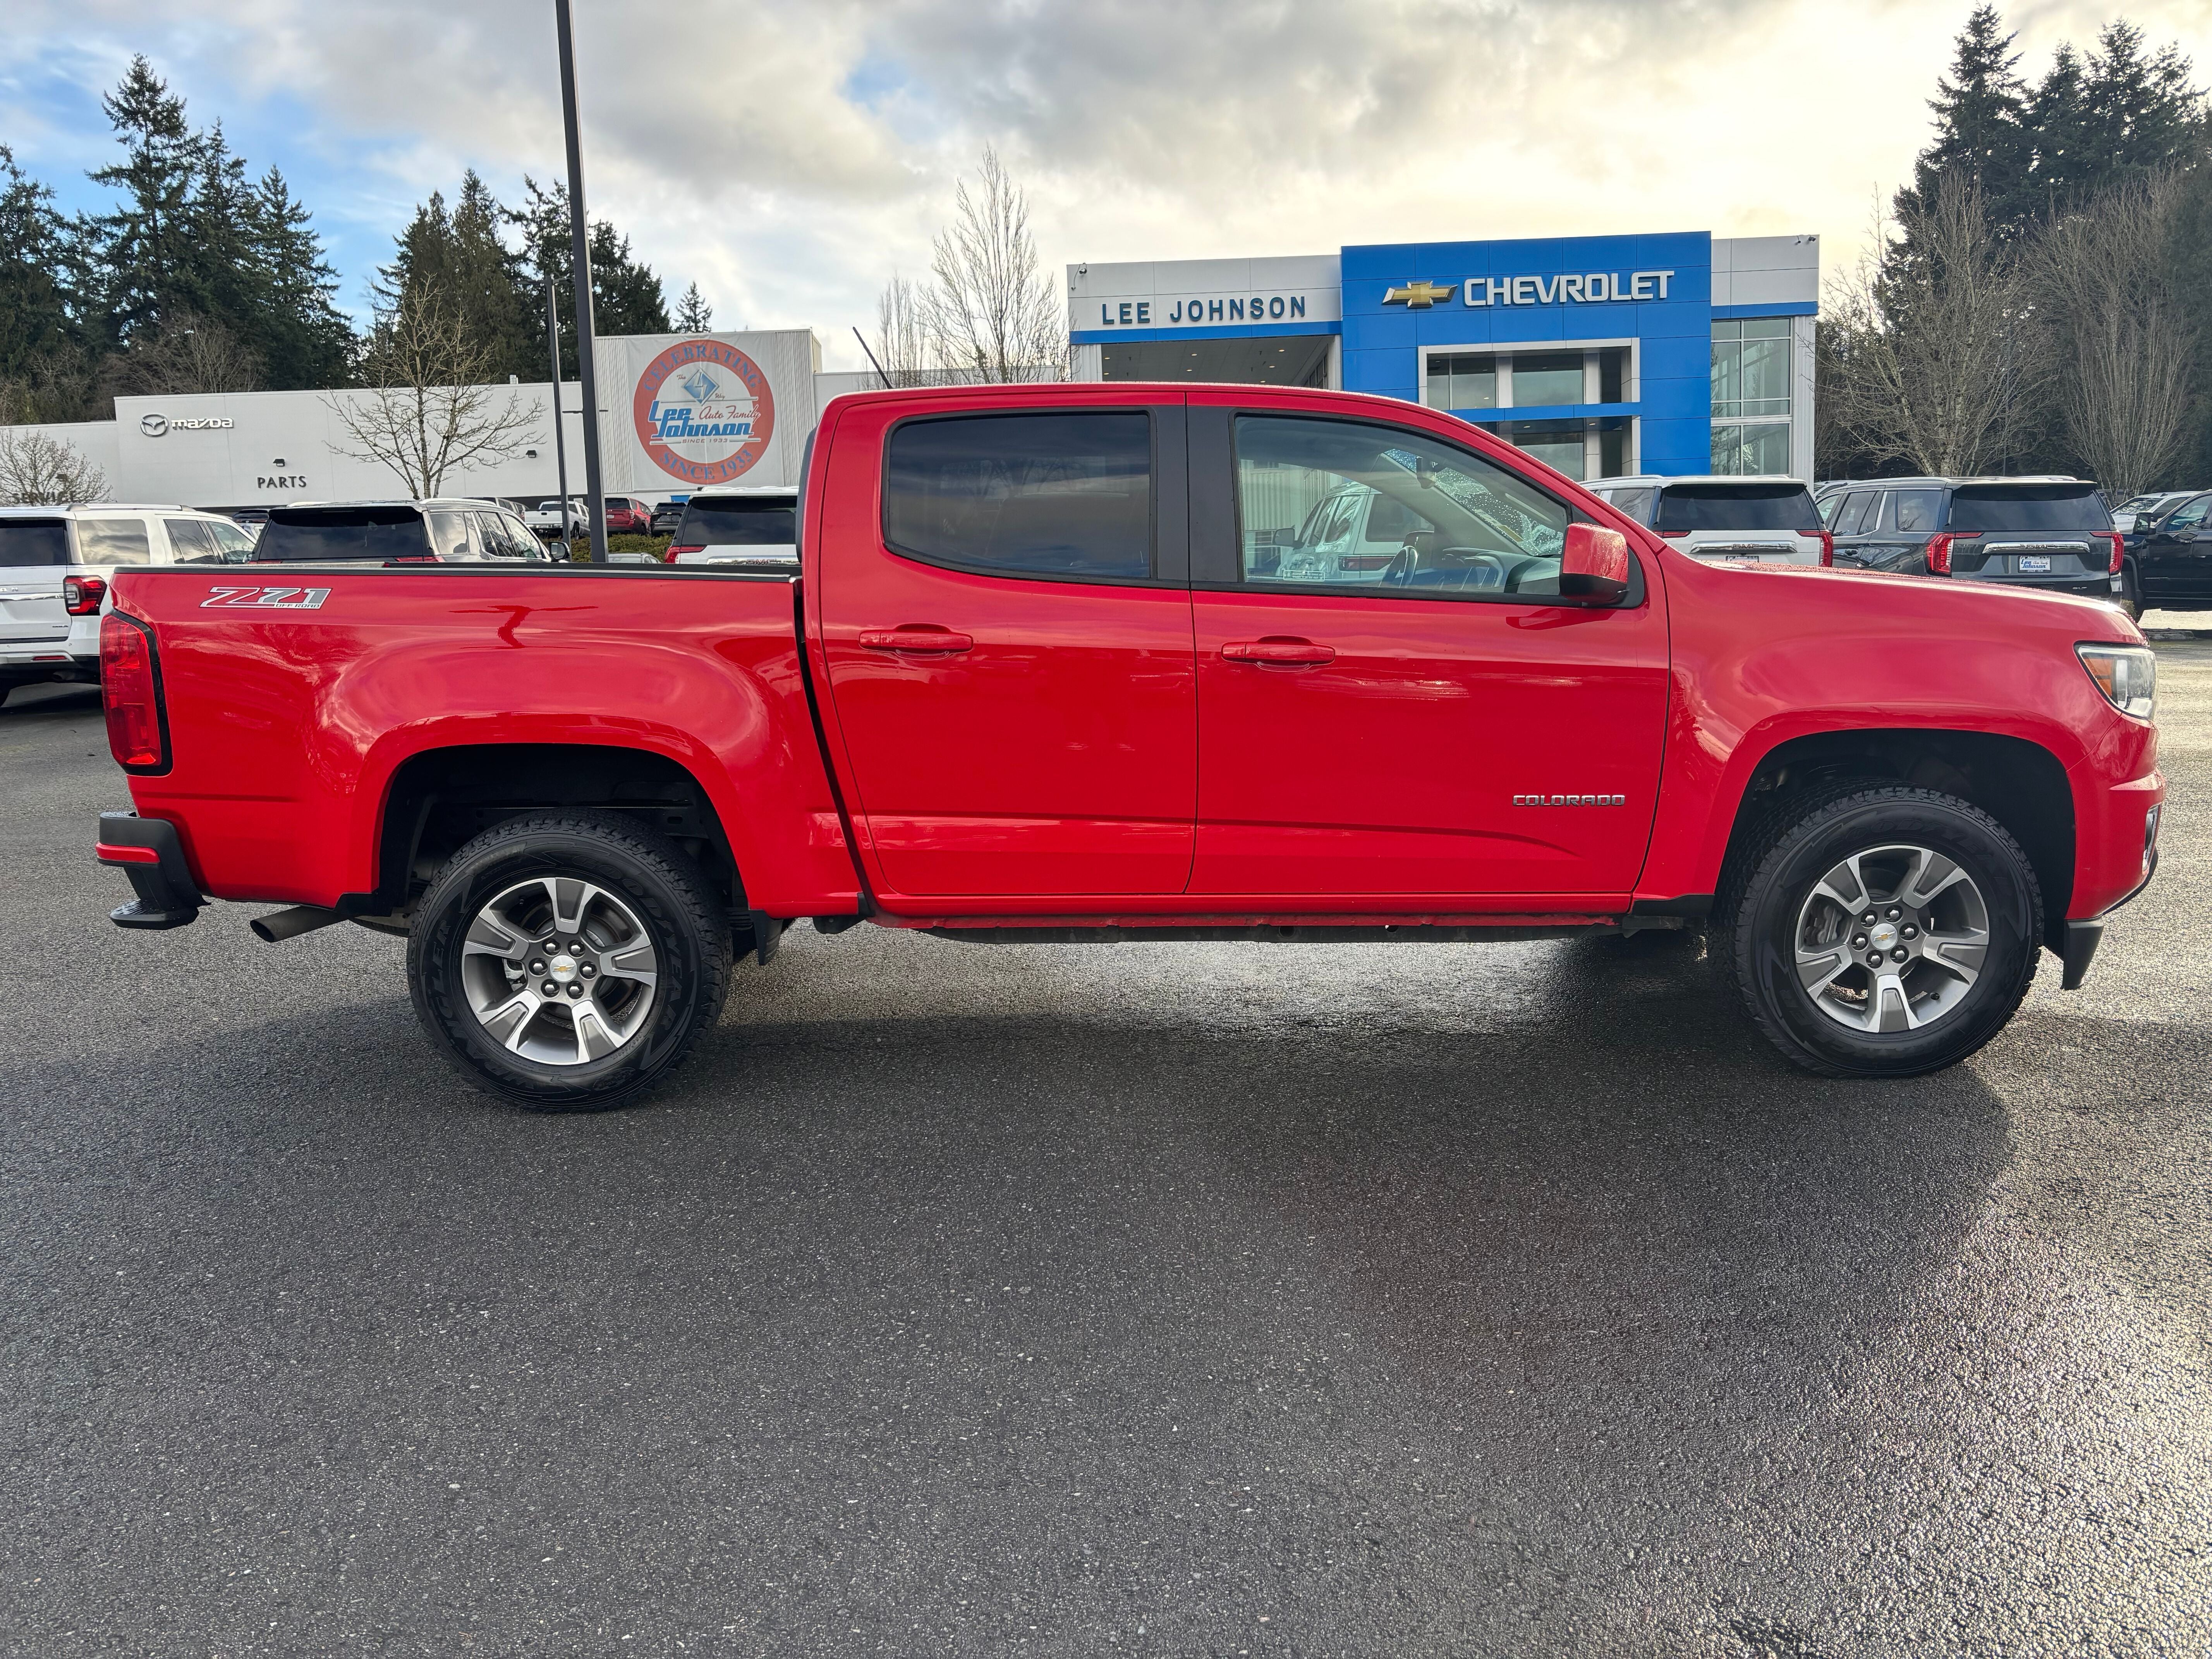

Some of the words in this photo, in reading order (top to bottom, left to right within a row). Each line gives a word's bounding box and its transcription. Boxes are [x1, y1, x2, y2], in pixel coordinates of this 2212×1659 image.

[1464, 270, 1674, 306] CHEVROLET
[1102, 302, 1151, 325] LEE
[1170, 296, 1305, 323] JOHNSON
[644, 344, 762, 391] CELEBRATING
[171, 417, 234, 429] mazda
[648, 400, 694, 421] Lee
[699, 406, 724, 420] Auto
[726, 404, 761, 424] Family
[652, 416, 754, 438] Johnson
[659, 451, 715, 480] SINCE
[720, 449, 753, 477] 1933
[257, 476, 307, 489] PARTS
[199, 586, 333, 609] Z71
[1513, 795, 1625, 806] COLORADO
[572, 855, 683, 1031] GOODYEAR
[431, 919, 536, 1091] WRANGLER
